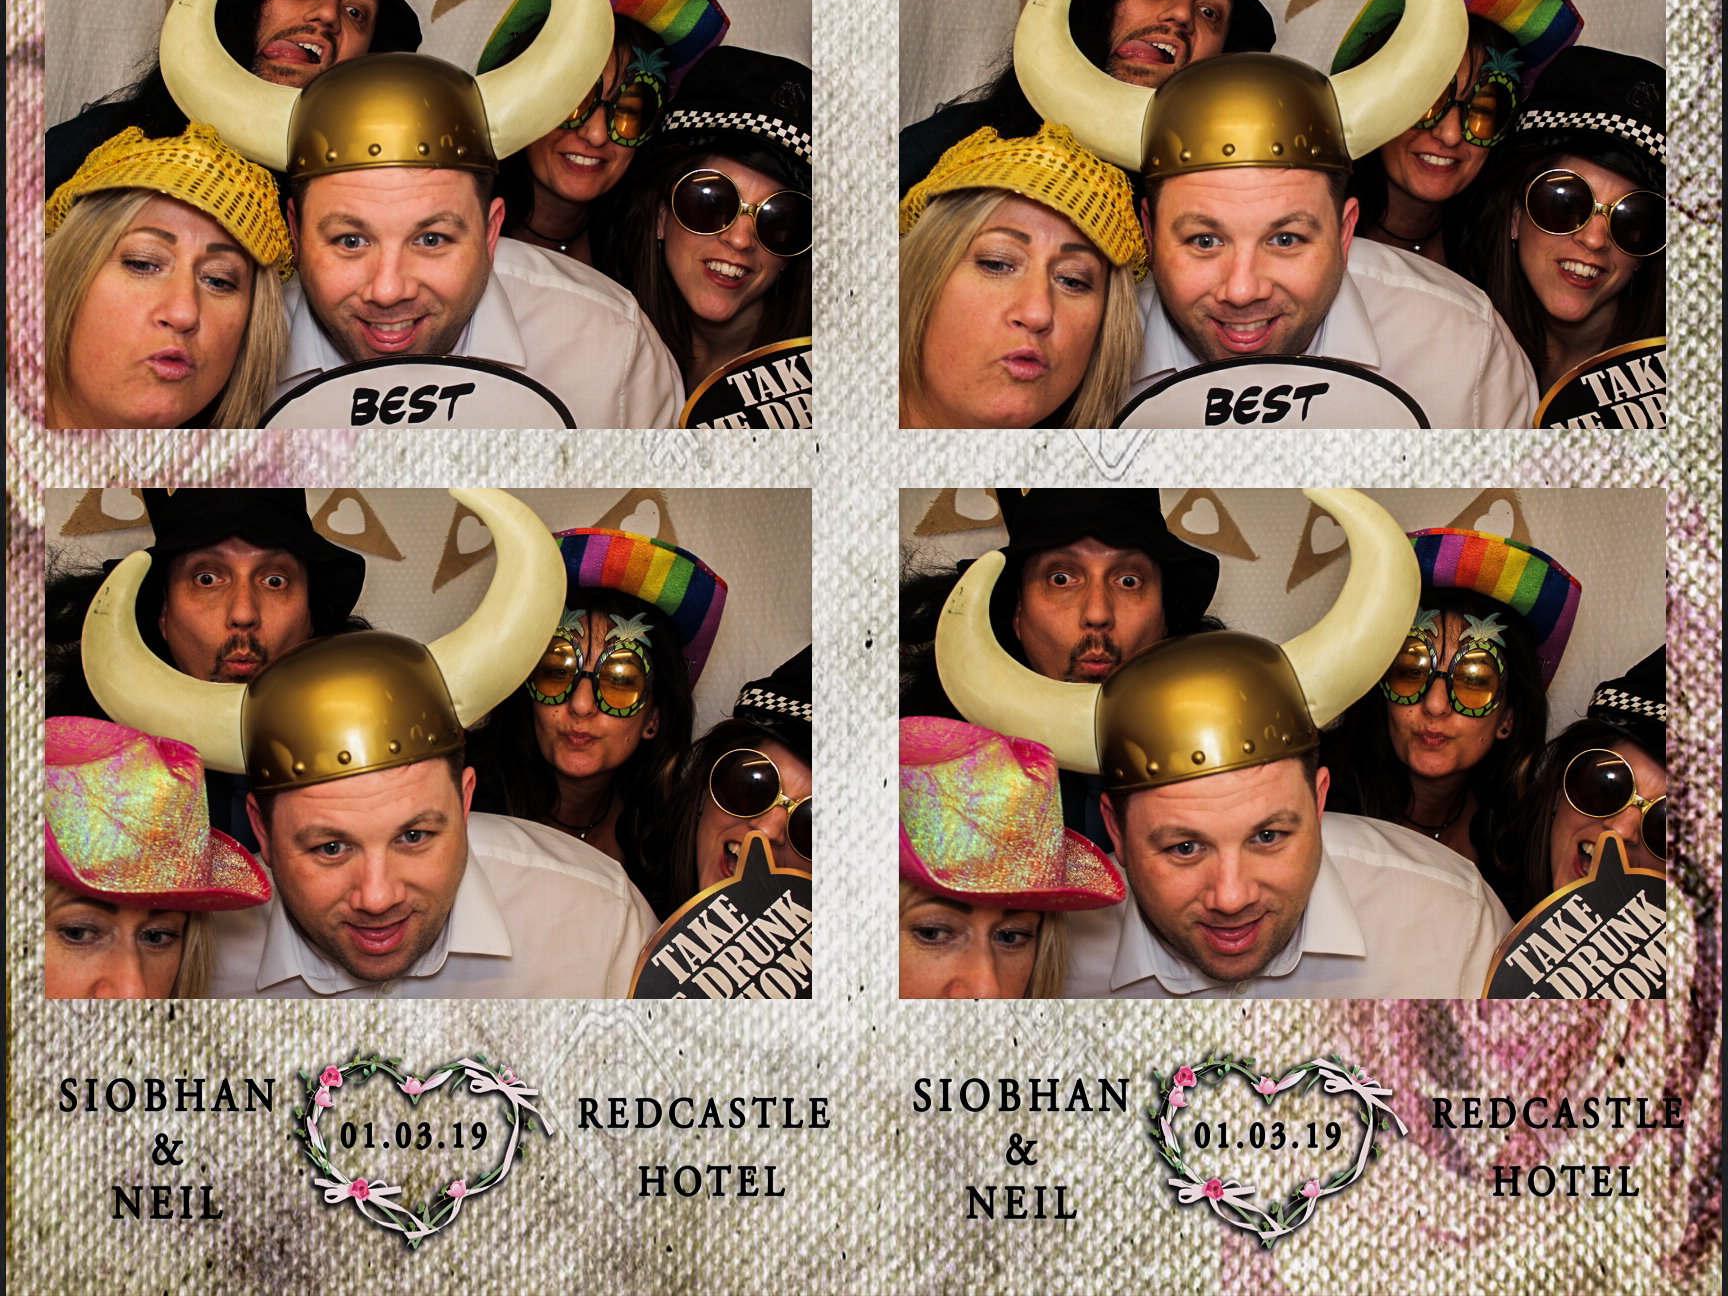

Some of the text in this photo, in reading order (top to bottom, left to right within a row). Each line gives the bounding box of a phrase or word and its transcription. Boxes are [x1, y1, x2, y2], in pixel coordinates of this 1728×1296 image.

[350, 382, 476, 427] BEST
[726, 350, 813, 407] TAK
[1204, 382, 1330, 427] BEST
[1580, 350, 1667, 407] TAK
[651, 893, 750, 985] TAKE
[691, 889, 813, 1000] DRUNK
[1505, 893, 1604, 985] TAKE
[1545, 889, 1667, 1000] DRUNK
